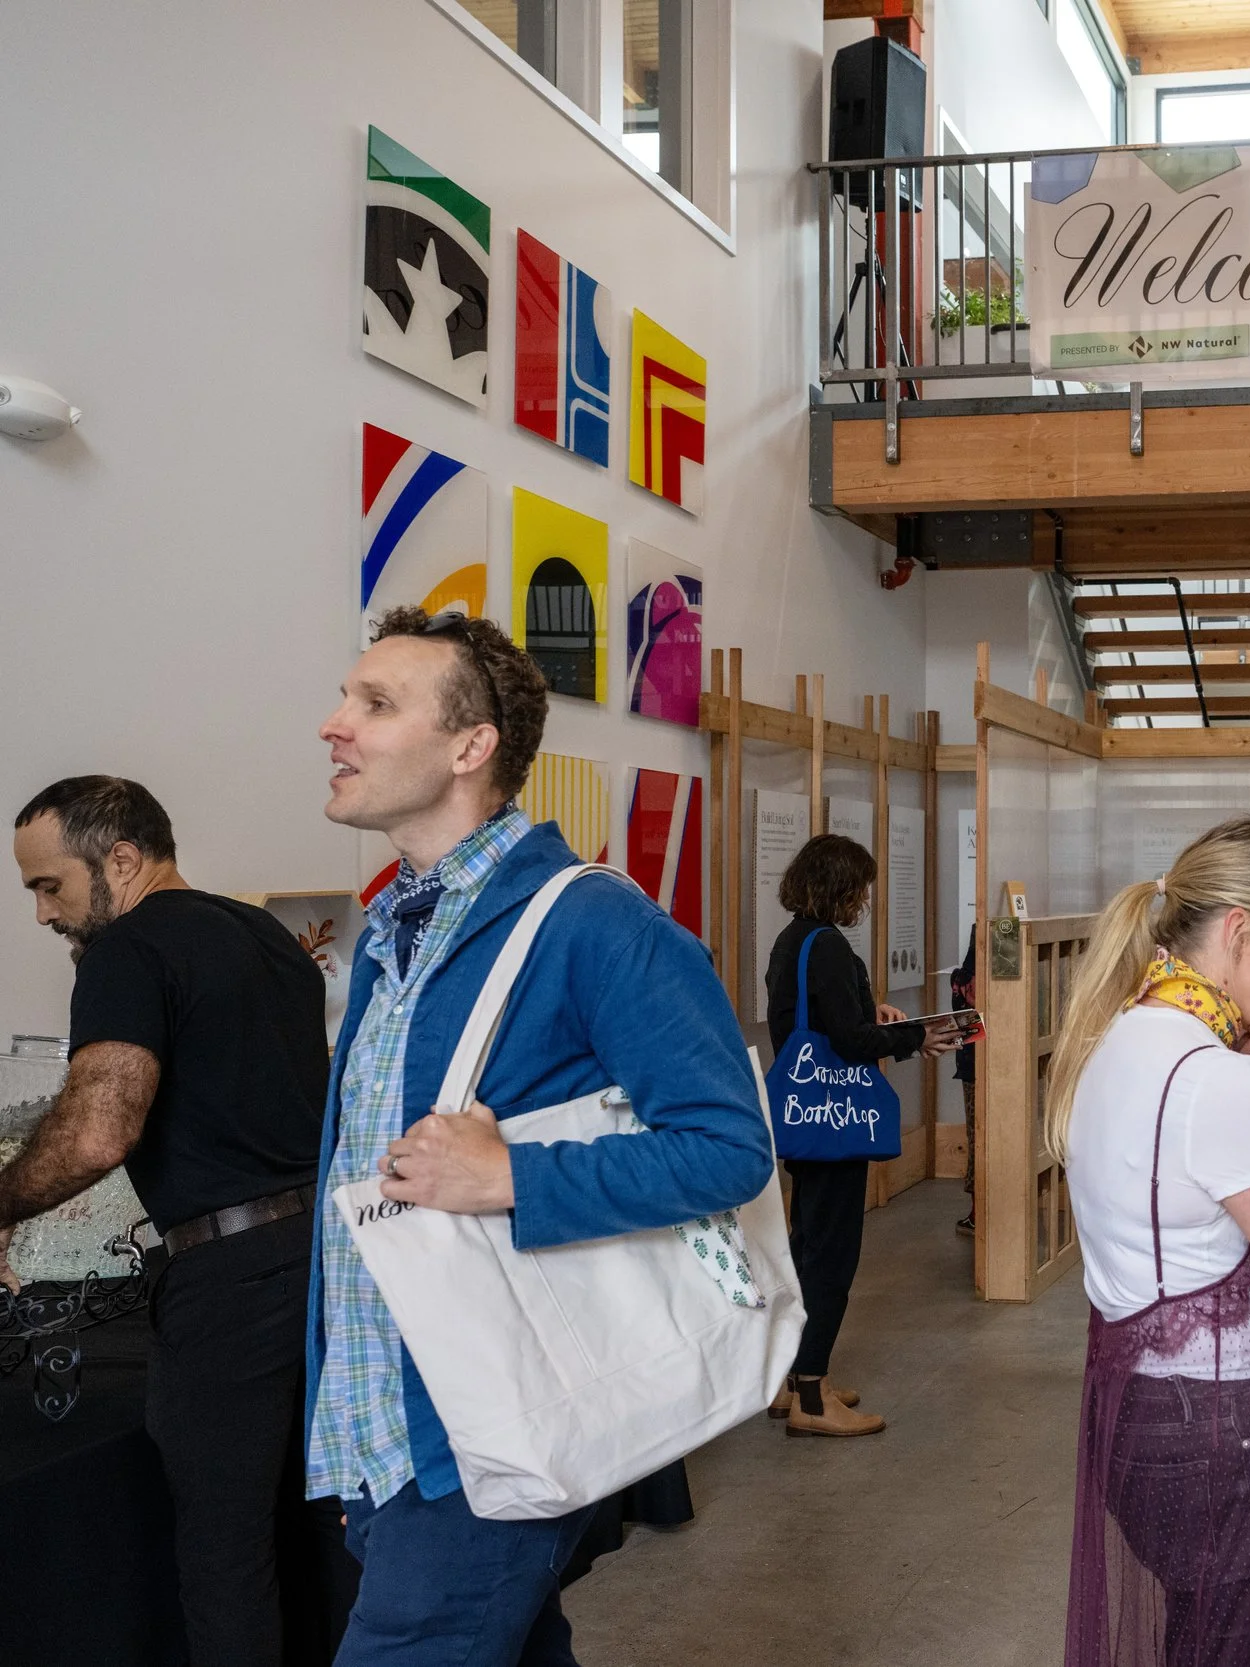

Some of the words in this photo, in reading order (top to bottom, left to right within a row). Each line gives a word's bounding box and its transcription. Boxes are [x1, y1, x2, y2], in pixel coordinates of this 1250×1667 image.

[1060, 346, 1108, 355] PRESENTED
[1110, 345, 1119, 353] BY
[1161, 340, 1181, 350] NW
[787, 1042, 873, 1087] Browsers
[784, 1089, 880, 1142] Bookshop
